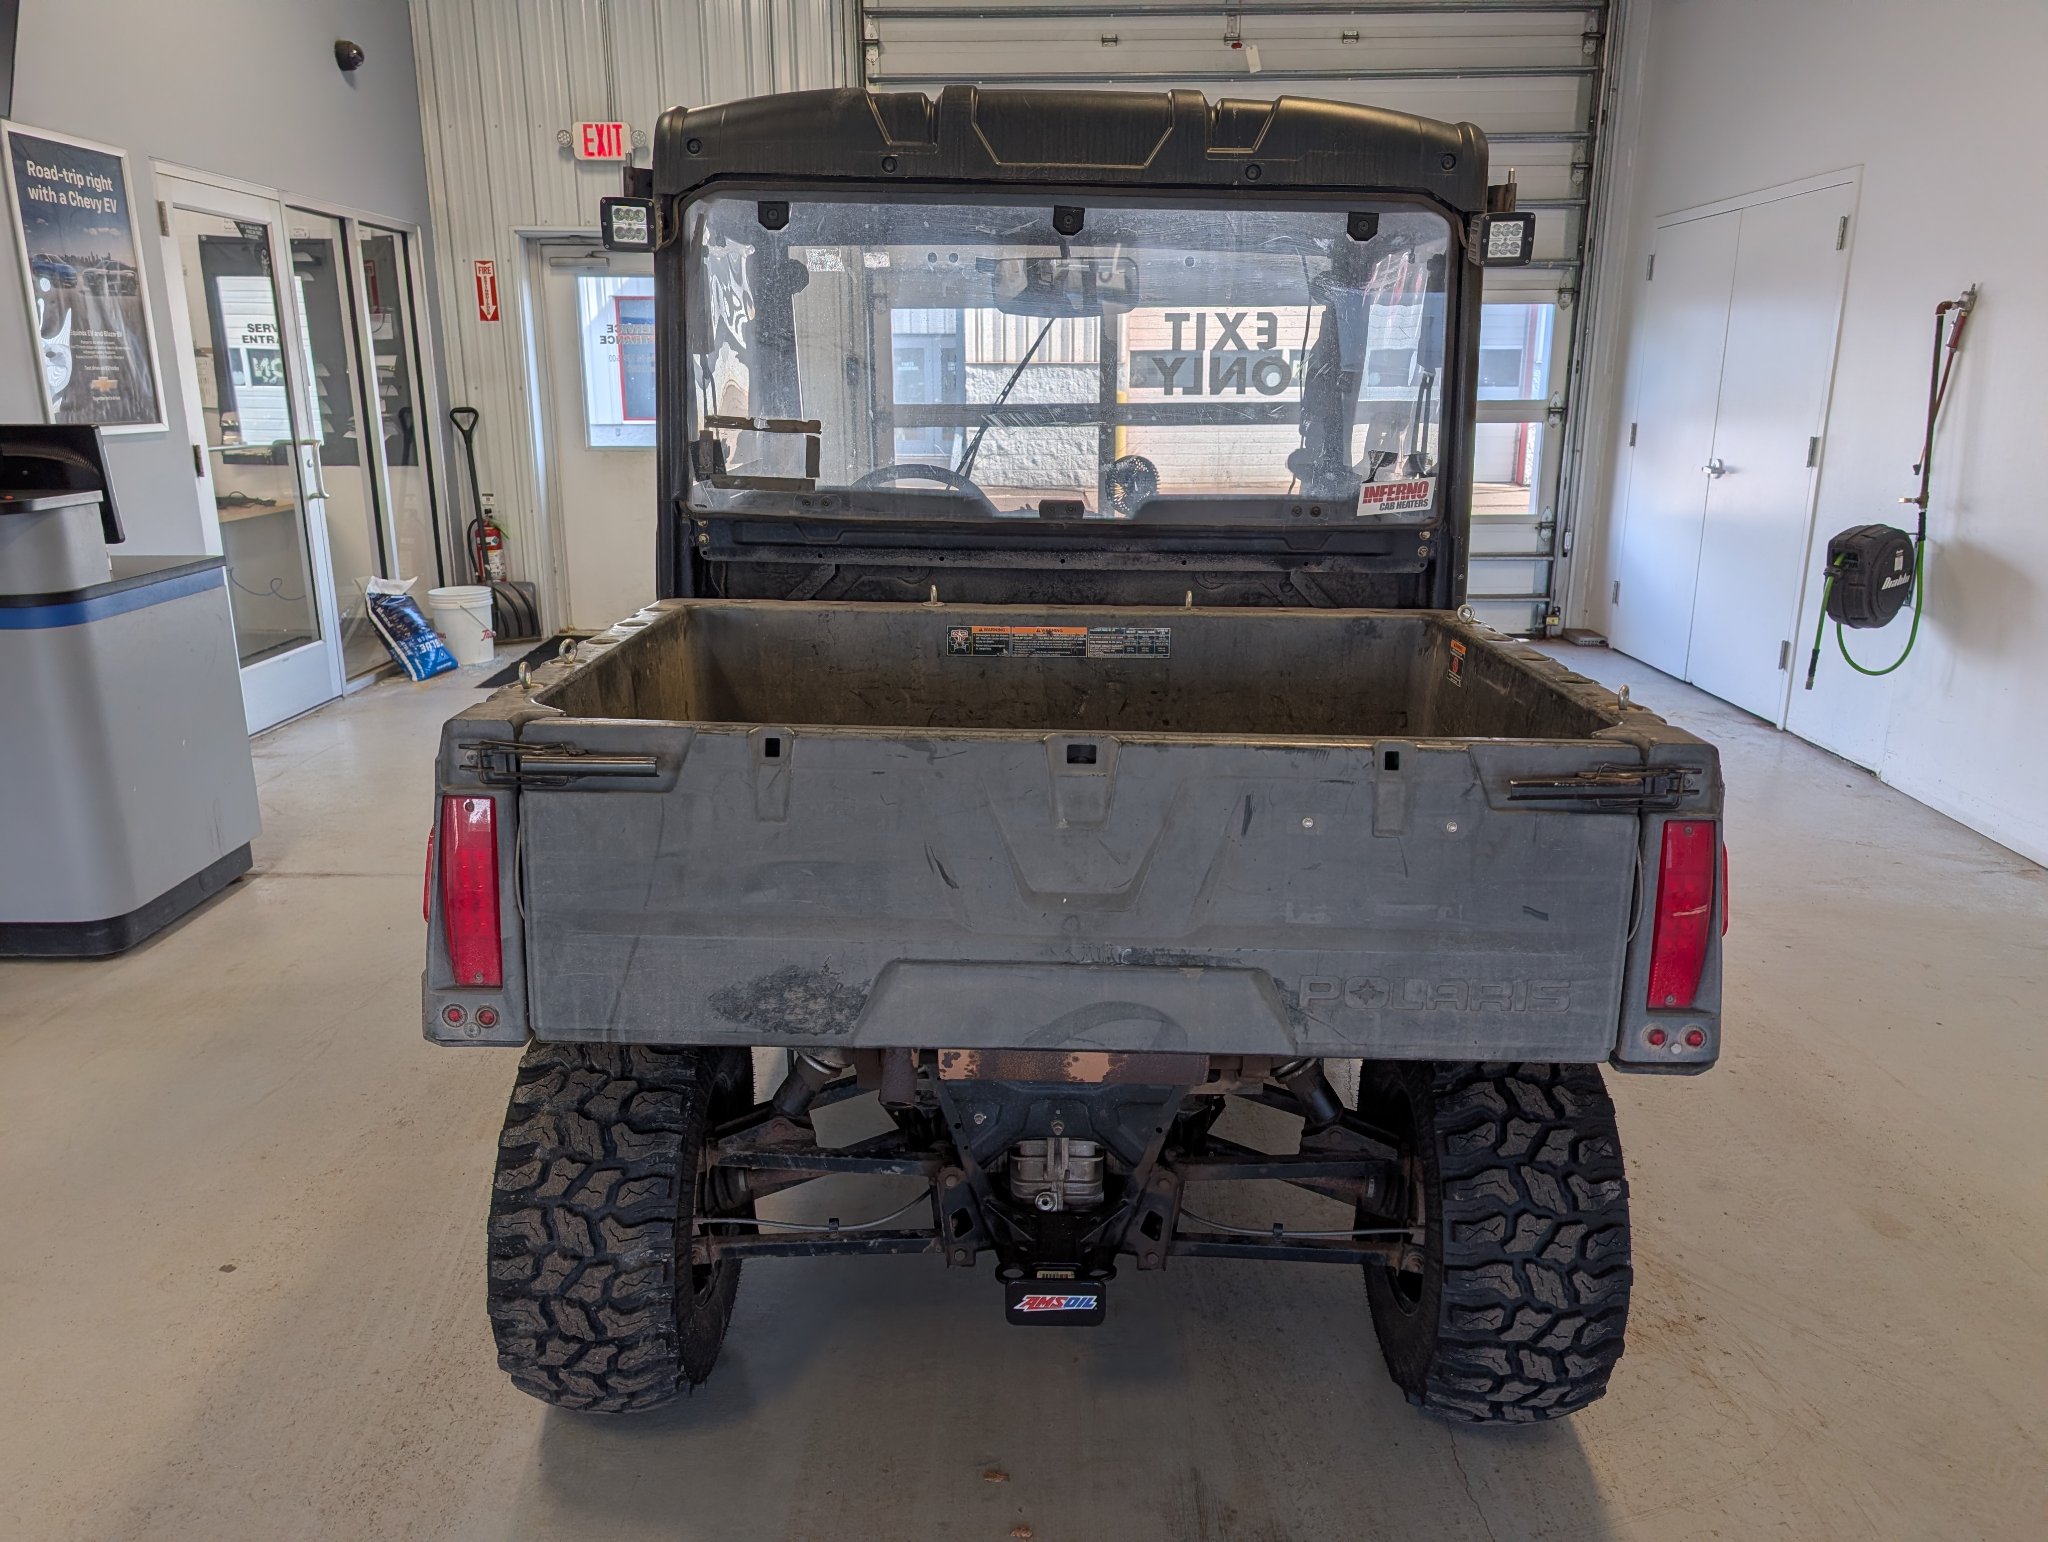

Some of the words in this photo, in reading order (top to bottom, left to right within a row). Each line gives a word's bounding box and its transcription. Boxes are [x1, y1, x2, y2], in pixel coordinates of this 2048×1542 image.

[583, 123, 622, 157] EXIT
[26, 160, 85, 188] Road-trip
[86, 172, 113, 192] right
[27, 184, 57, 204] with
[59, 192, 67, 205] a
[68, 191, 102, 214] Chevy
[104, 197, 117, 213] EV
[242, 335, 280, 344] ENTR
[1362, 481, 1429, 504] INFERNO
[1379, 502, 1395, 511] CAB
[1396, 499, 1429, 510] HEATERS
[1299, 975, 1571, 1013] POLARIS
[1014, 1294, 1098, 1312] AMSOIL
